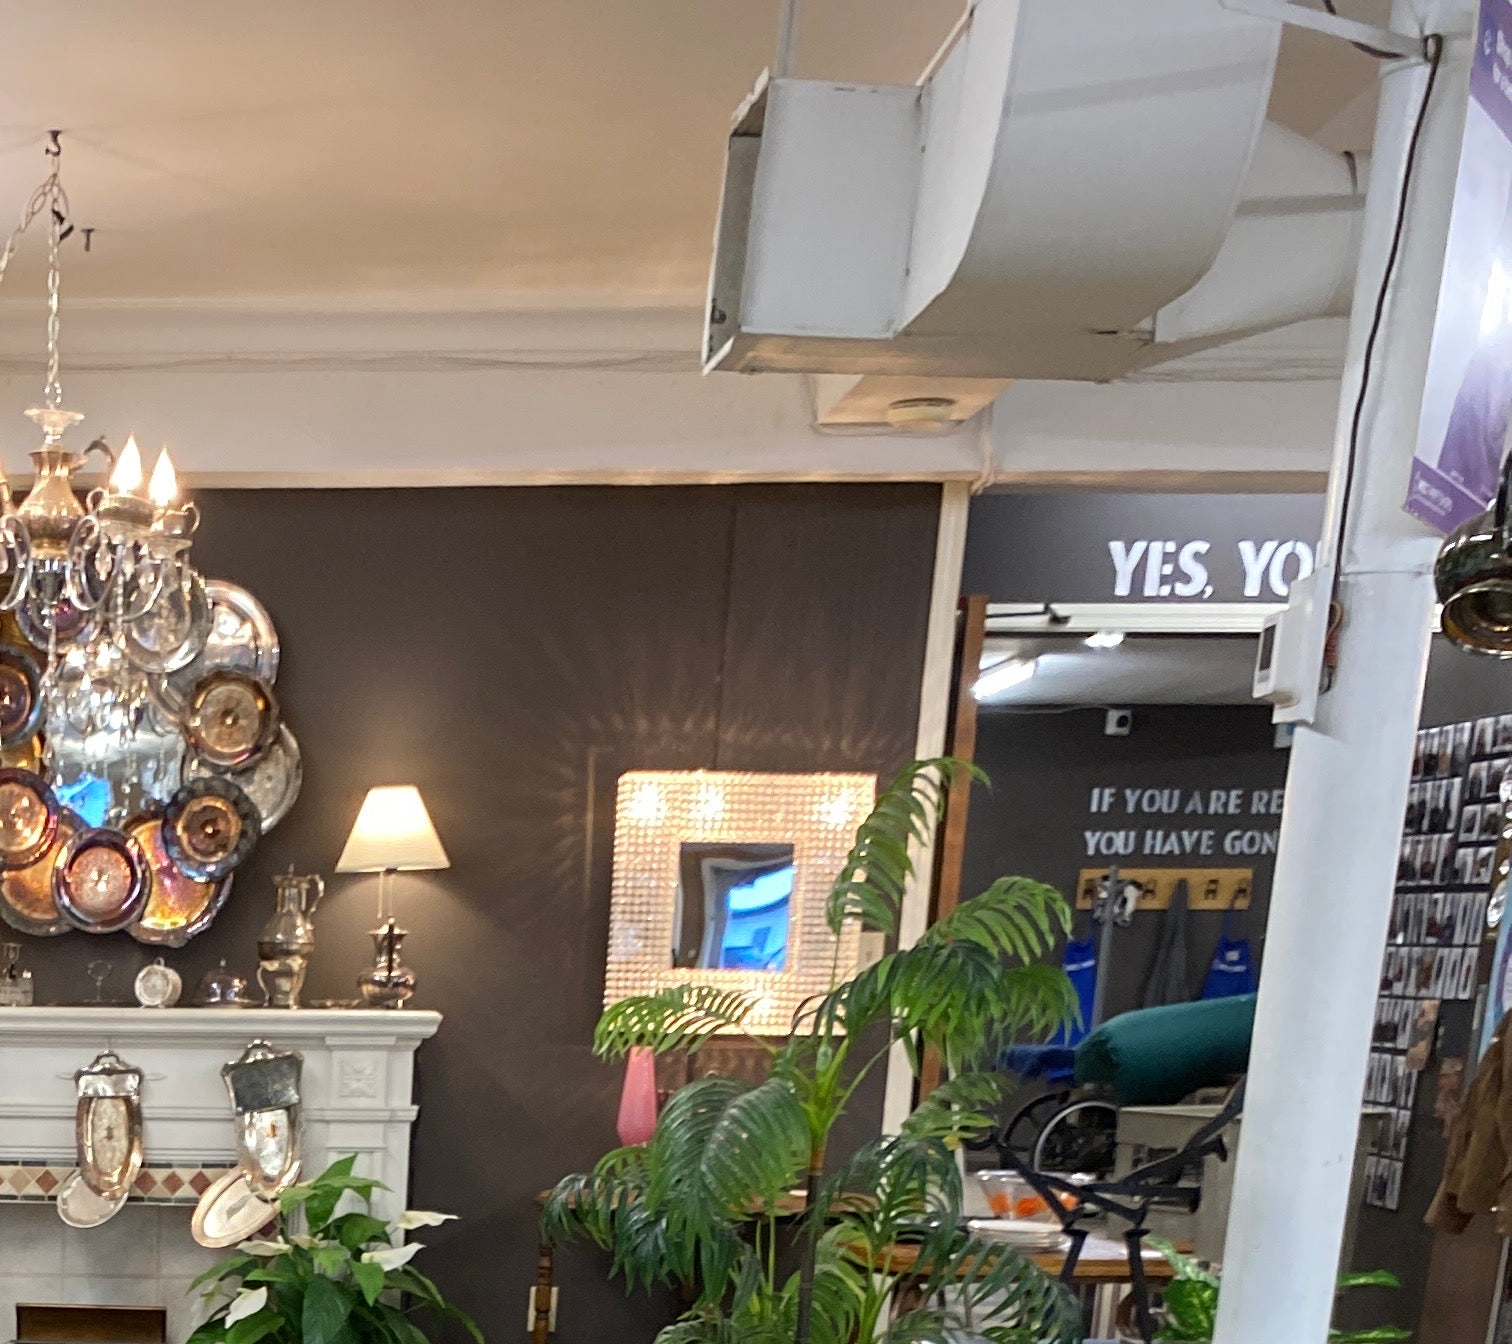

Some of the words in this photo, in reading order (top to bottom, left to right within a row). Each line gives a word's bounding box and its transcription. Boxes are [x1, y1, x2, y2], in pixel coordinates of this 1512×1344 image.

[1108, 540, 1214, 599] YES,
[1238, 540, 1324, 598] YO
[1090, 787, 1117, 813] IF
[1124, 788, 1181, 814] YOU
[1184, 789, 1245, 815] ARE
[1084, 829, 1136, 856] YOU
[1142, 829, 1215, 855] HAVE
